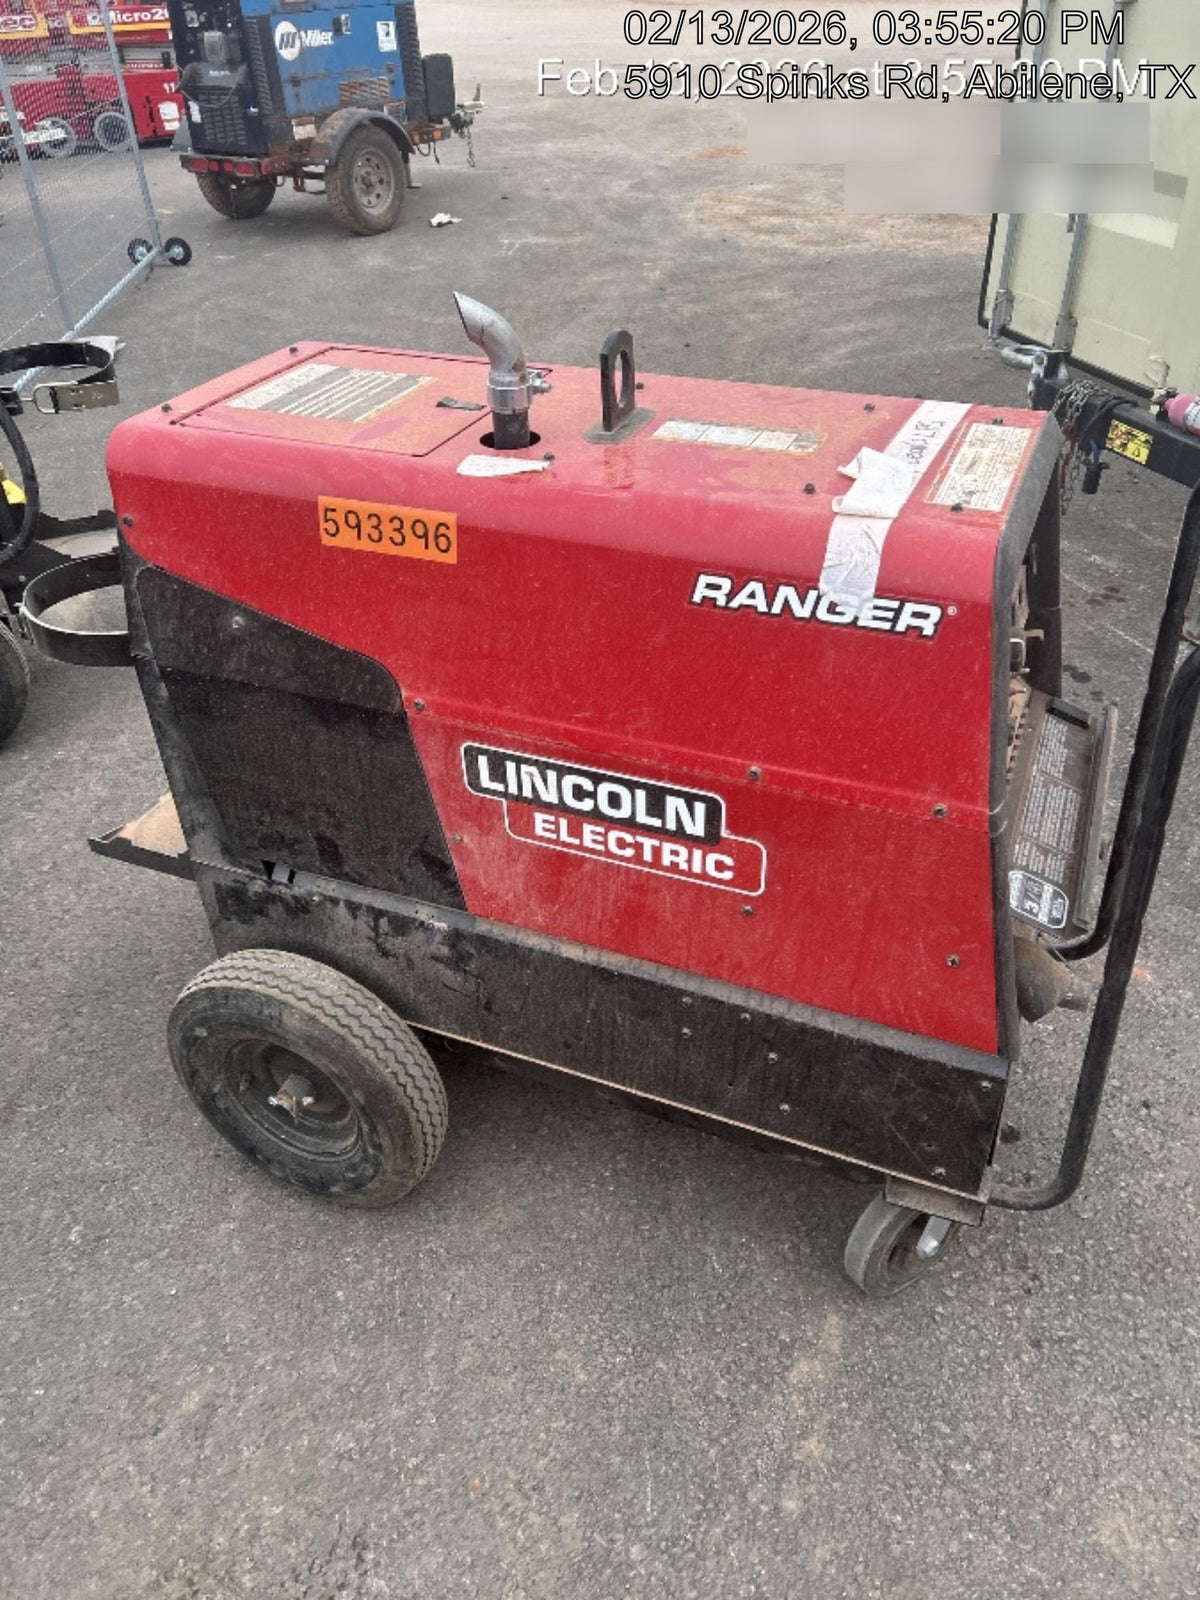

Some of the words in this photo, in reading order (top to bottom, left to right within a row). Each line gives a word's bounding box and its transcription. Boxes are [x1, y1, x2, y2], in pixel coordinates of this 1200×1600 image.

[321, 506, 454, 555] 593396
[690, 572, 944, 638] RANGER
[476, 754, 707, 838] LINCOLN
[533, 812, 735, 881] ELECTRIC
